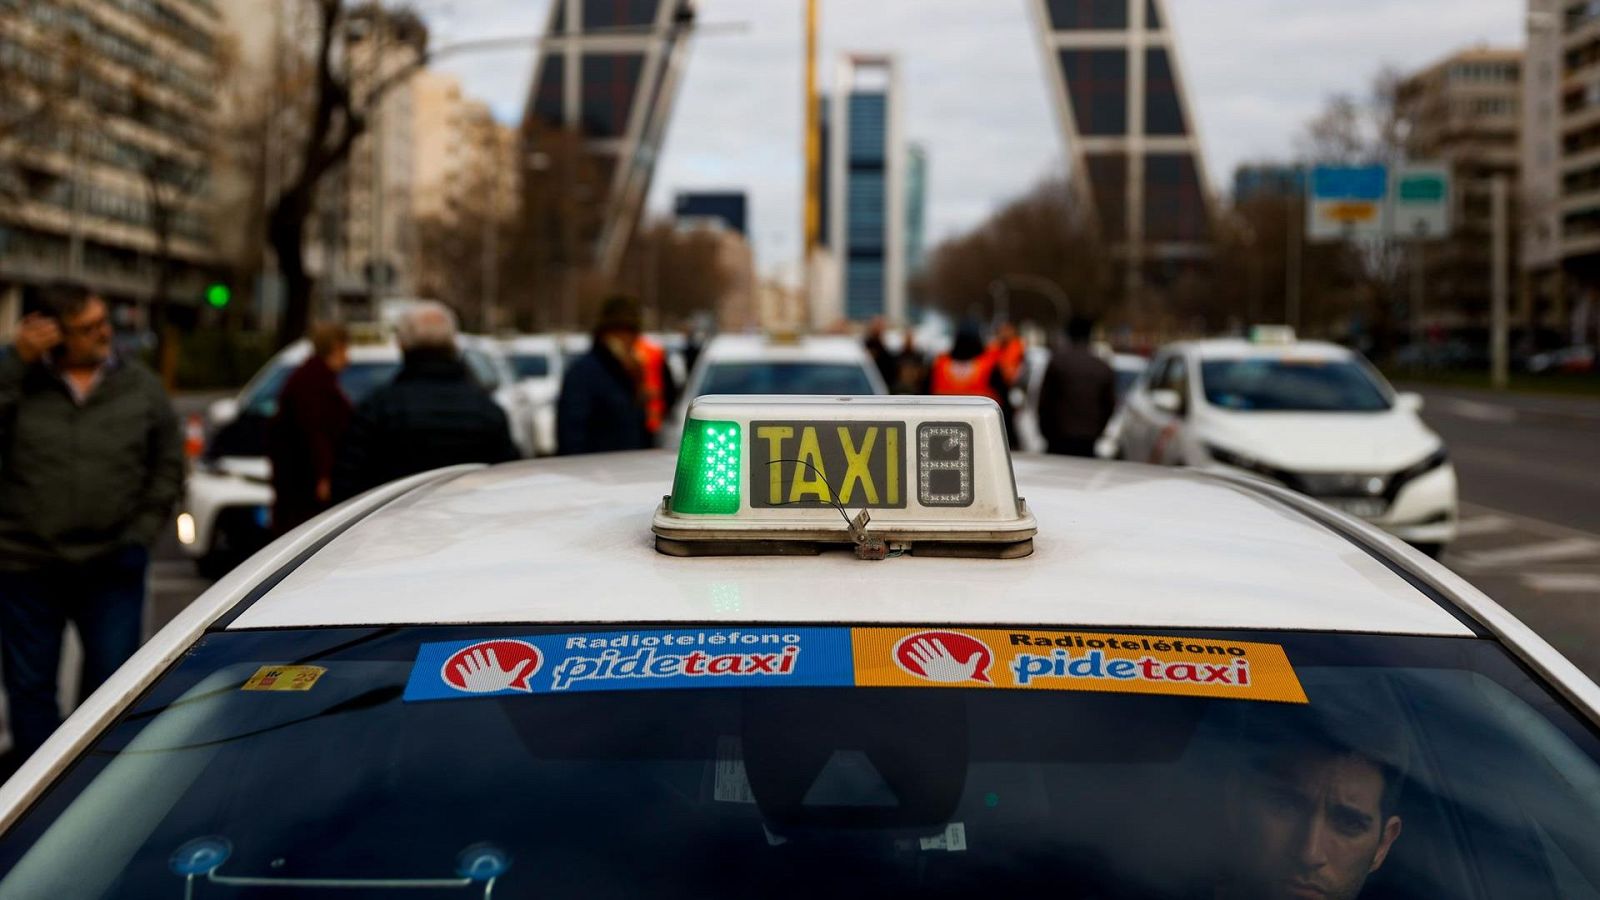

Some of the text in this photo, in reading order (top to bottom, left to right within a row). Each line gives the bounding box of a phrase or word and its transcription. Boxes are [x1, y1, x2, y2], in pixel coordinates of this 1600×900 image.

[757, 427, 898, 504] TAXI
[566, 632, 800, 649] Radioteléfono
[1010, 633, 1246, 656] Radioteléfono
[552, 647, 801, 690] pidetaxi
[1012, 650, 1250, 686] pidetaxi
